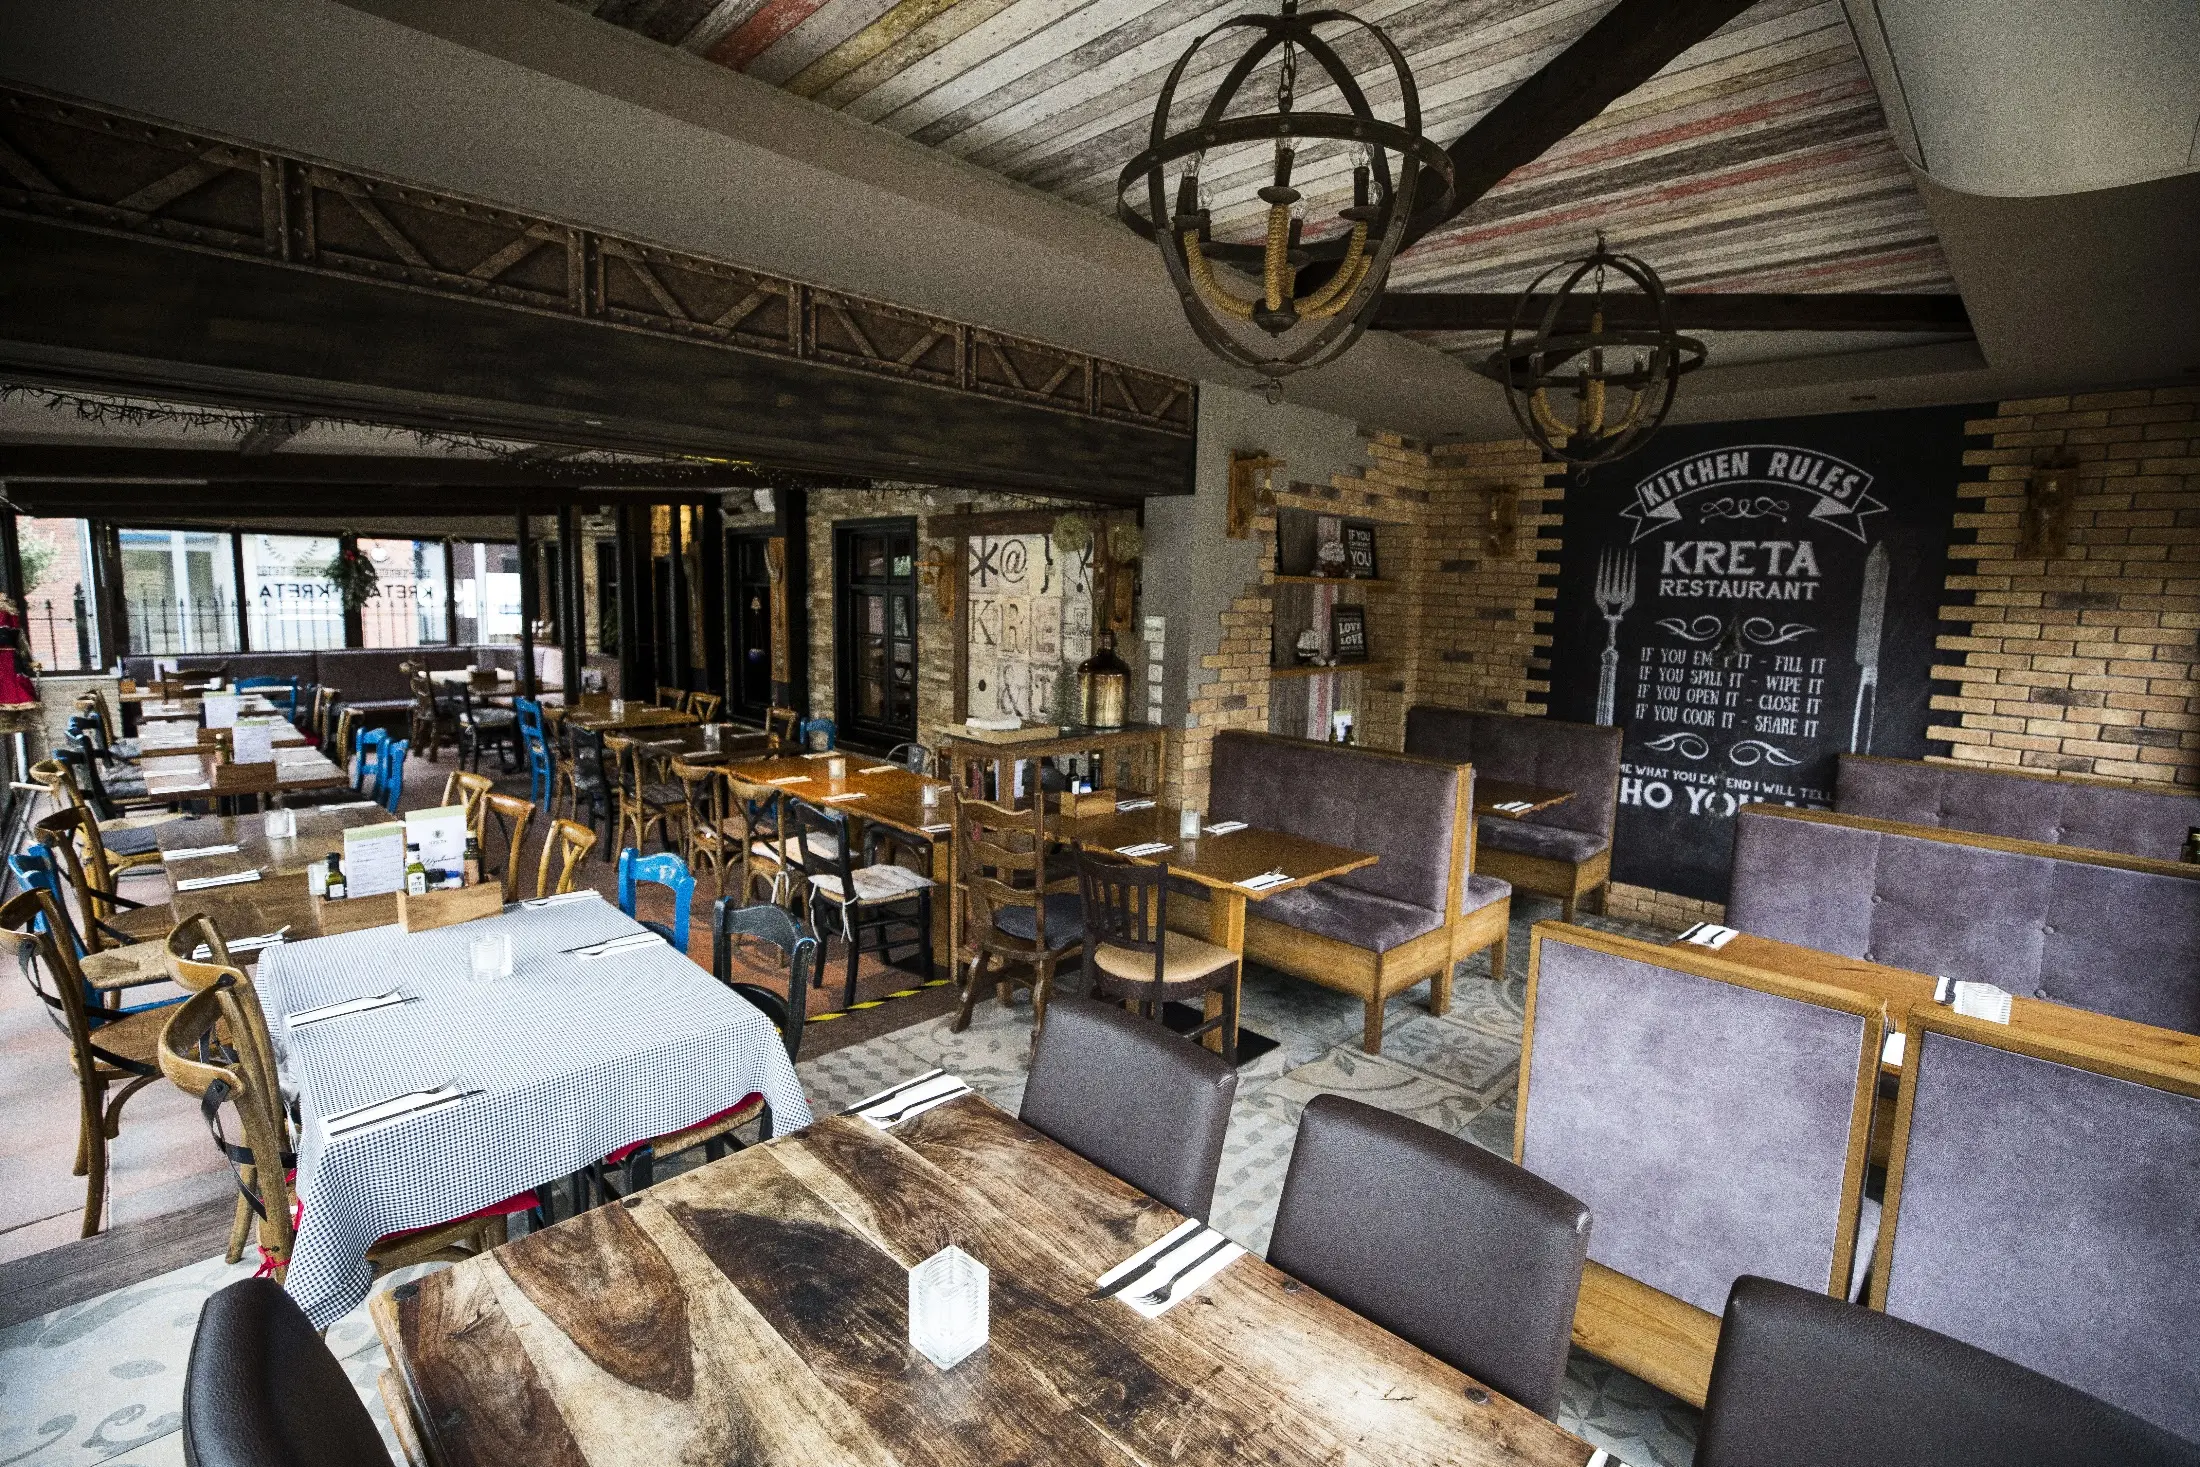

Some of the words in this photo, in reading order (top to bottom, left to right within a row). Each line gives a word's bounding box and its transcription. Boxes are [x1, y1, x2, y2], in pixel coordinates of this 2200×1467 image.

[1641, 452, 1750, 507] KITCHEN
[1767, 451, 1860, 499] RULES
[1357, 530, 1371, 541] YOU
[1350, 551, 1372, 566] YOU
[1661, 540, 1822, 577] KRETA
[1659, 579, 1820, 600] RESTAURANT
[1640, 647, 1654, 662] IF
[1661, 648, 1687, 665] YOU
[1737, 653, 1752, 670] IT
[1775, 655, 1802, 673] FILL
[1810, 657, 1826, 674] IT
[1639, 665, 1652, 681] IF
[1658, 667, 1684, 683] YOU
[1690, 669, 1722, 687] SPILL
[1729, 672, 1744, 688] IT
[1766, 675, 1802, 693] WIPE
[1808, 678, 1825, 695] IT
[1637, 684, 1650, 699] IF
[1656, 685, 1681, 701] YOU
[1686, 688, 1720, 706] OPEN
[1725, 691, 1740, 707] IT
[1758, 694, 1800, 713] CLOSE
[1806, 698, 1822, 715] IT
[1635, 703, 1648, 720] IF
[1654, 705, 1678, 722] YOU
[1682, 707, 1715, 727] COOK
[1721, 711, 1735, 729] IT
[1754, 715, 1798, 736] SHARE
[1803, 720, 1819, 738] IT
[1620, 777, 1673, 809] HO
[1635, 765, 1669, 779] WHAT
[1673, 770, 1697, 783] YOU
[1700, 773, 1717, 785] EA
[1762, 782, 1795, 797] WILL
